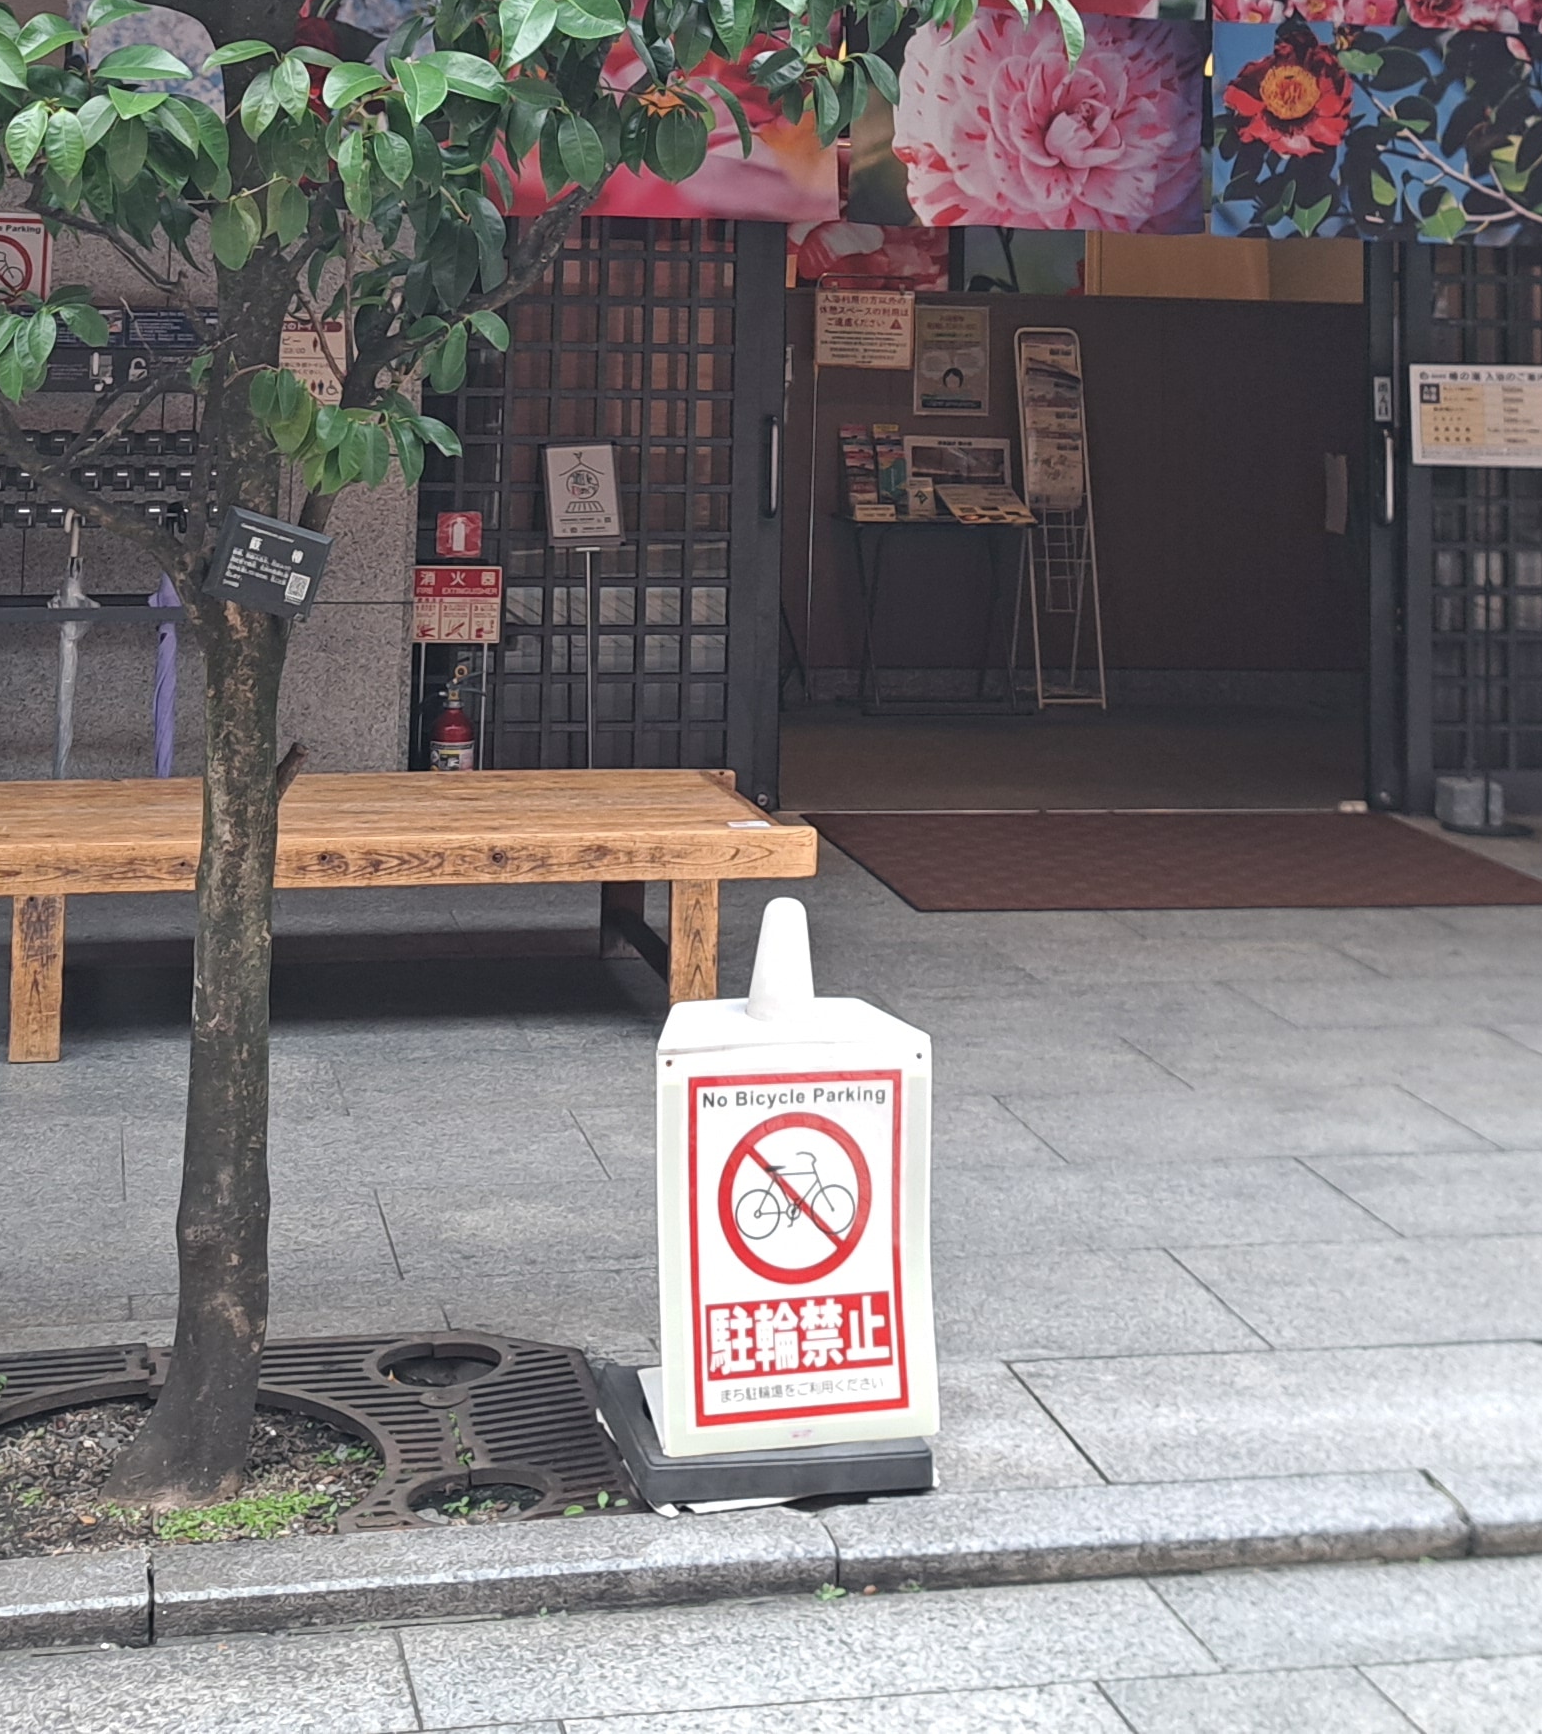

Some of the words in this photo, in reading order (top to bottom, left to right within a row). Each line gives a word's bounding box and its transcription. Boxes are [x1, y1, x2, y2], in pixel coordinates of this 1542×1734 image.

[6, 225, 41, 234] Parking
[420, 570, 496, 586] 消火器
[416, 587, 434, 595] FIRE
[702, 1092, 728, 1108] No
[735, 1088, 806, 1109] Bicycle
[813, 1086, 886, 1105] Parking
[709, 1295, 890, 1375] 駐輪禁止
